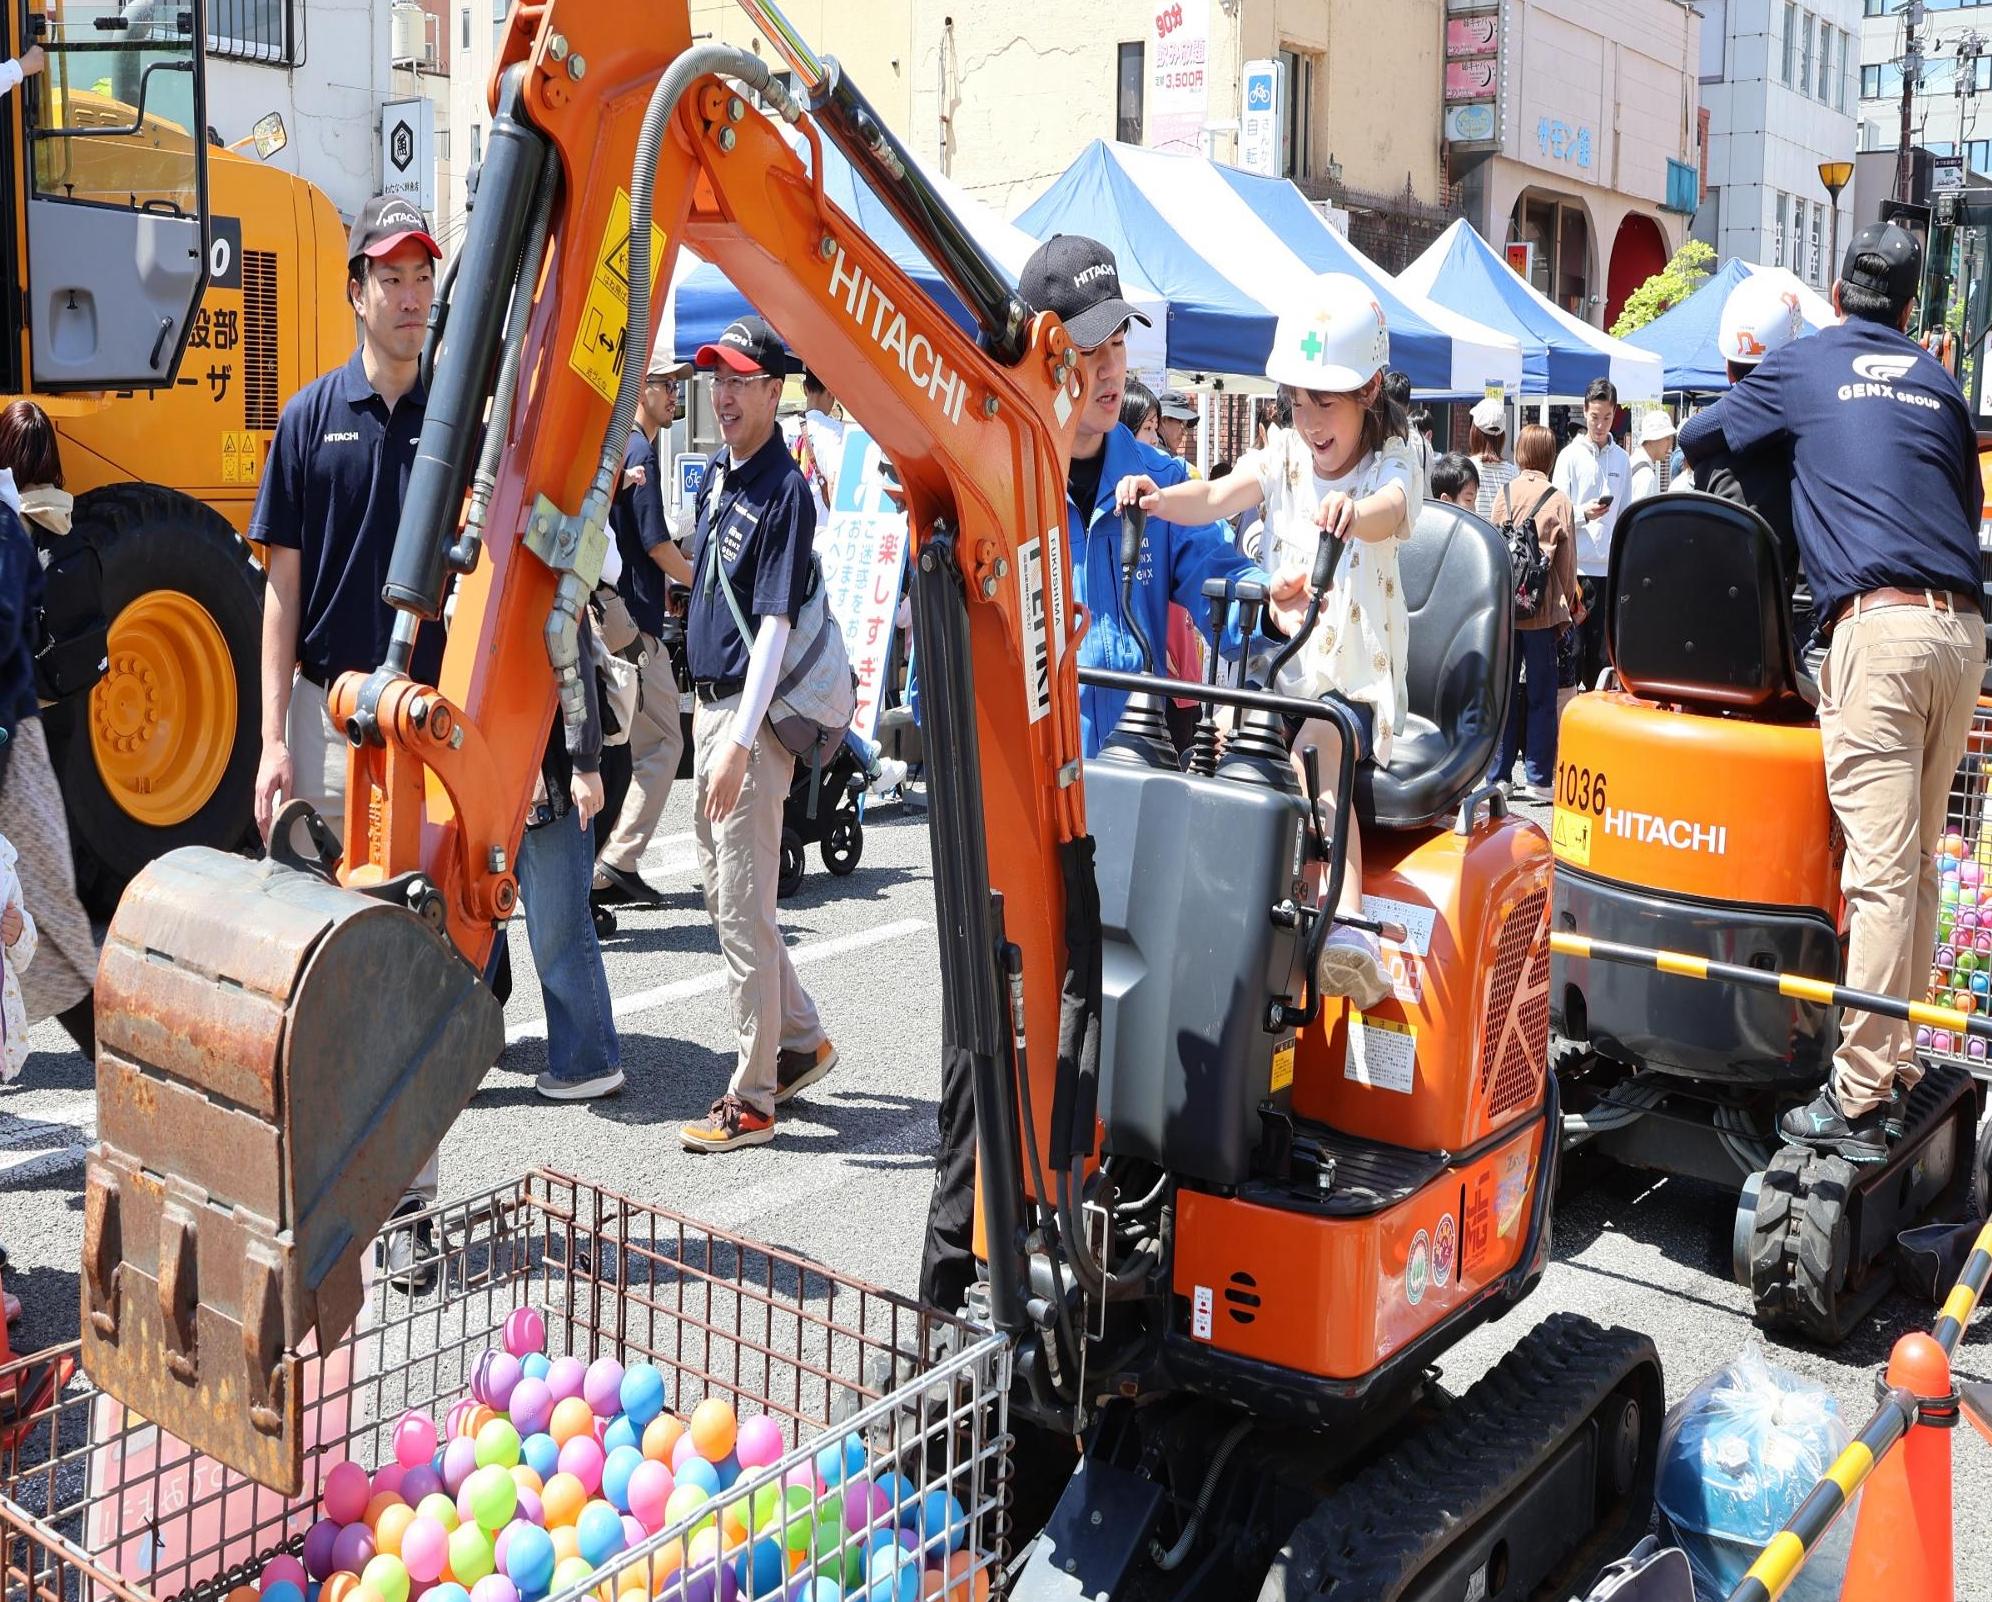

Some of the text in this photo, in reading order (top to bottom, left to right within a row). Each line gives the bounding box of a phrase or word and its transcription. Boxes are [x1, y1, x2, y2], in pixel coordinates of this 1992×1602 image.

[1166, 70, 1203, 89] 3,500円
[1073, 262, 1116, 289] HITACHI
[828, 247, 967, 427] HITACHI
[1838, 383, 1941, 410] GENX GROUP
[324, 431, 359, 443] HITACHI
[1050, 538, 1061, 627] FUKUSHIMA
[855, 532, 902, 729] 楽しすぎて
[1558, 760, 1608, 816] 1036
[1604, 806, 1728, 855] HITACHI
